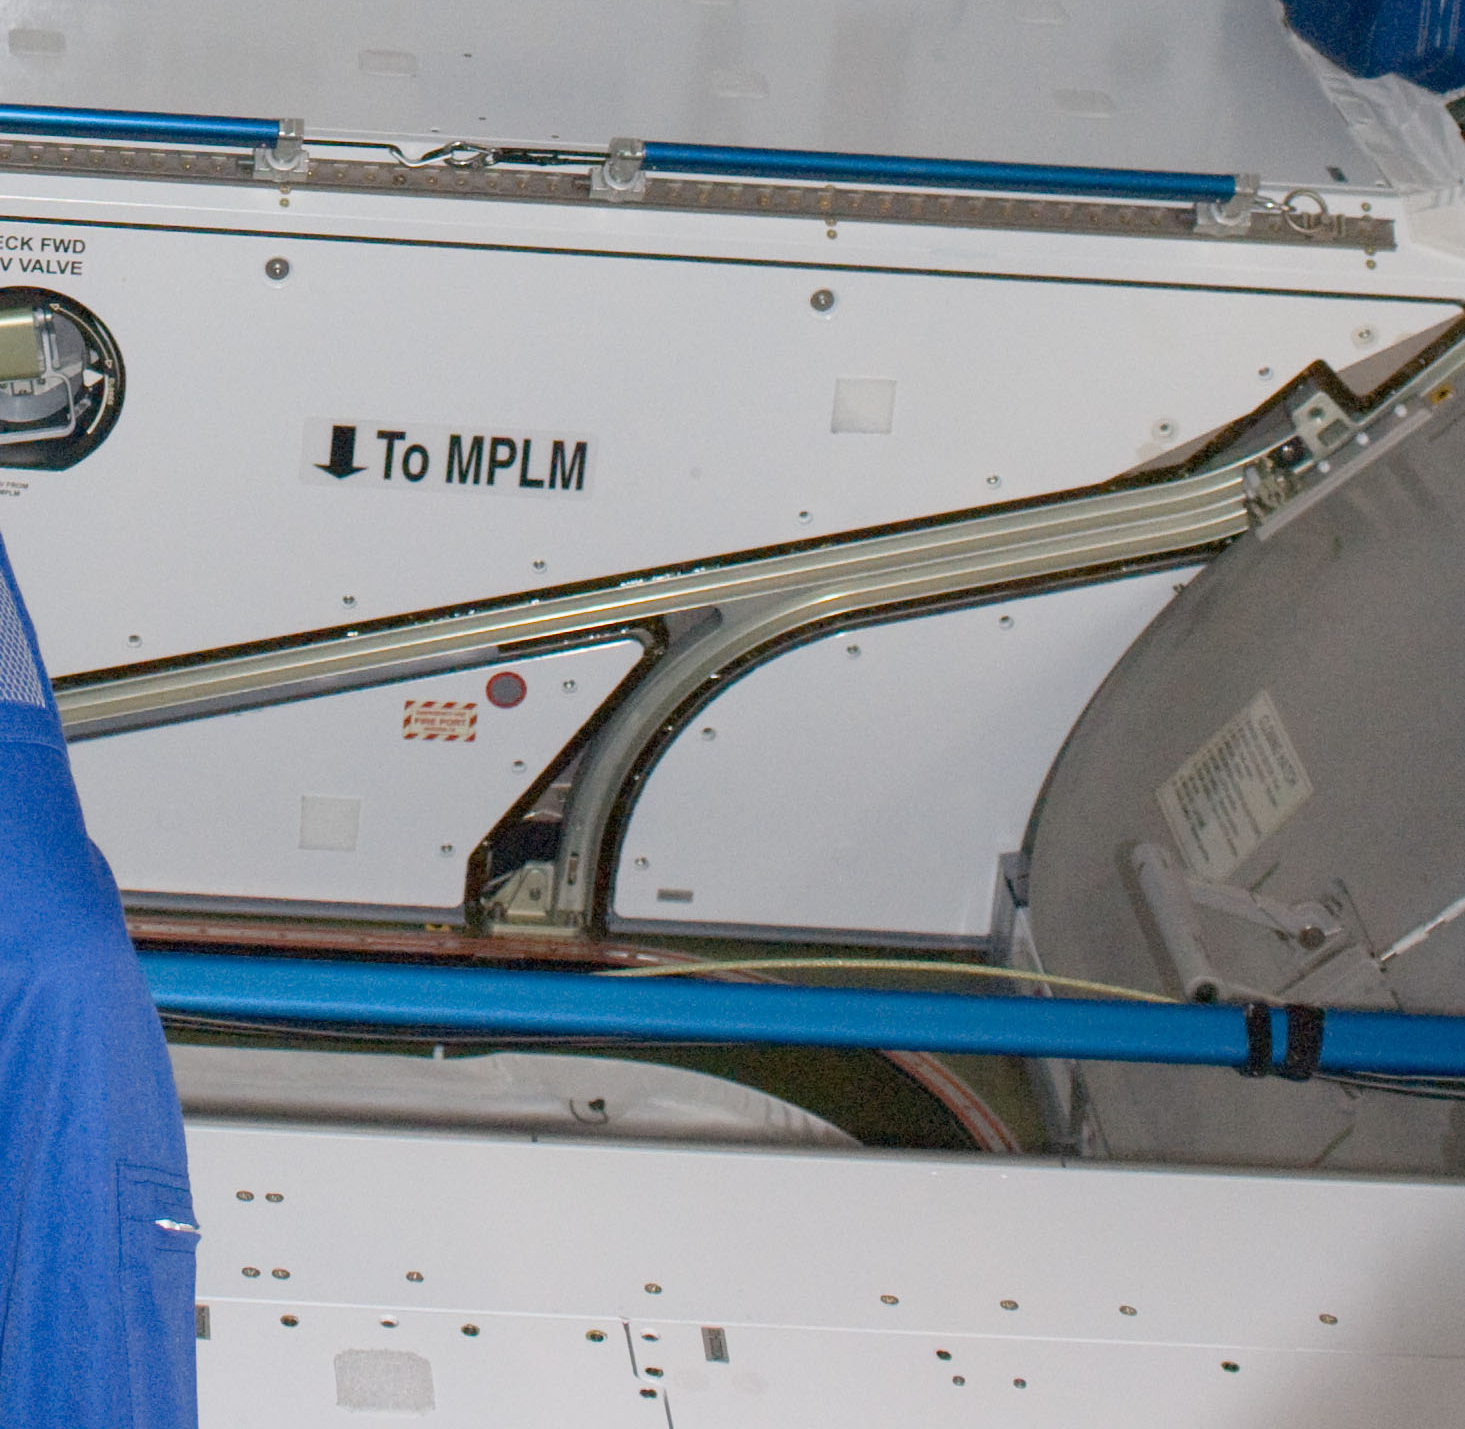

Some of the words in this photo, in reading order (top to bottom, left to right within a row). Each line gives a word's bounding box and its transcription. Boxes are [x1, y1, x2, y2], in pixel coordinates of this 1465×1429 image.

[40, 237, 87, 254] FWD
[18, 257, 84, 276] VALVE
[376, 430, 430, 483] To
[445, 434, 588, 491] MPLM
